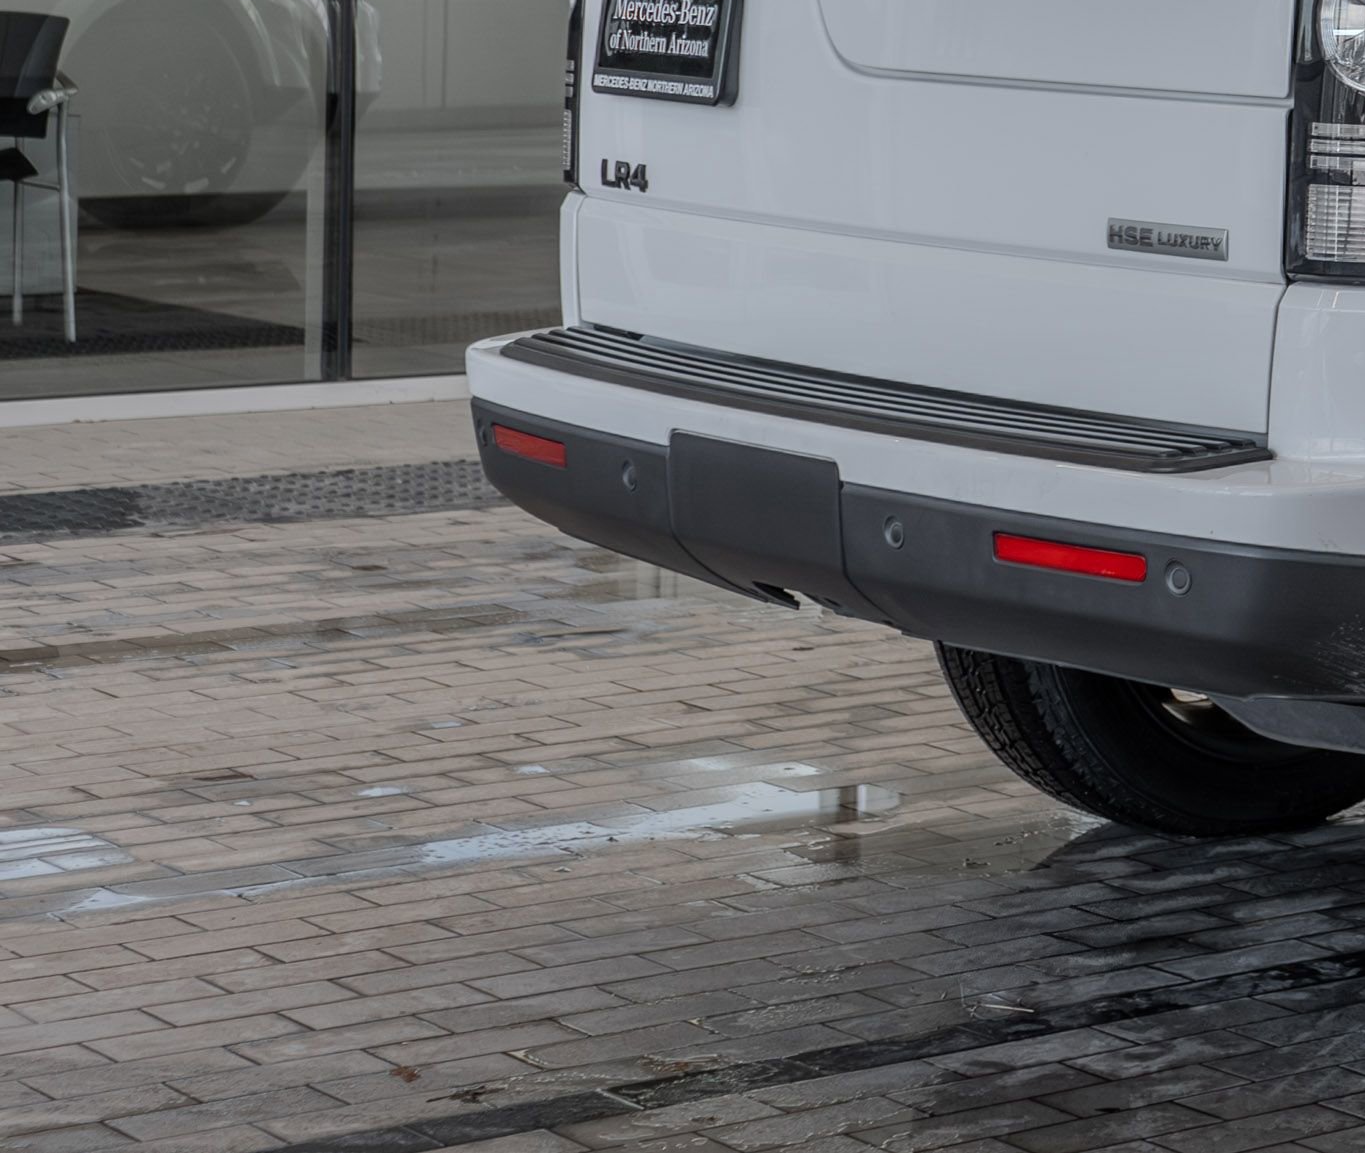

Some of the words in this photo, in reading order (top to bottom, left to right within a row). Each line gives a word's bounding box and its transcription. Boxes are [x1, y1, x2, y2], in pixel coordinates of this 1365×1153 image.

[609, 30, 622, 49] of
[620, 30, 667, 54] Northern
[667, 32, 709, 57] Arizona
[593, 74, 647, 91] MERCEDES-BENZ
[647, 79, 683, 94] NORTHERN
[683, 83, 714, 98] ARIZONA
[601, 158, 649, 193] LR4
[1109, 224, 1153, 247] HSE
[1157, 231, 1223, 251] LUXURY
